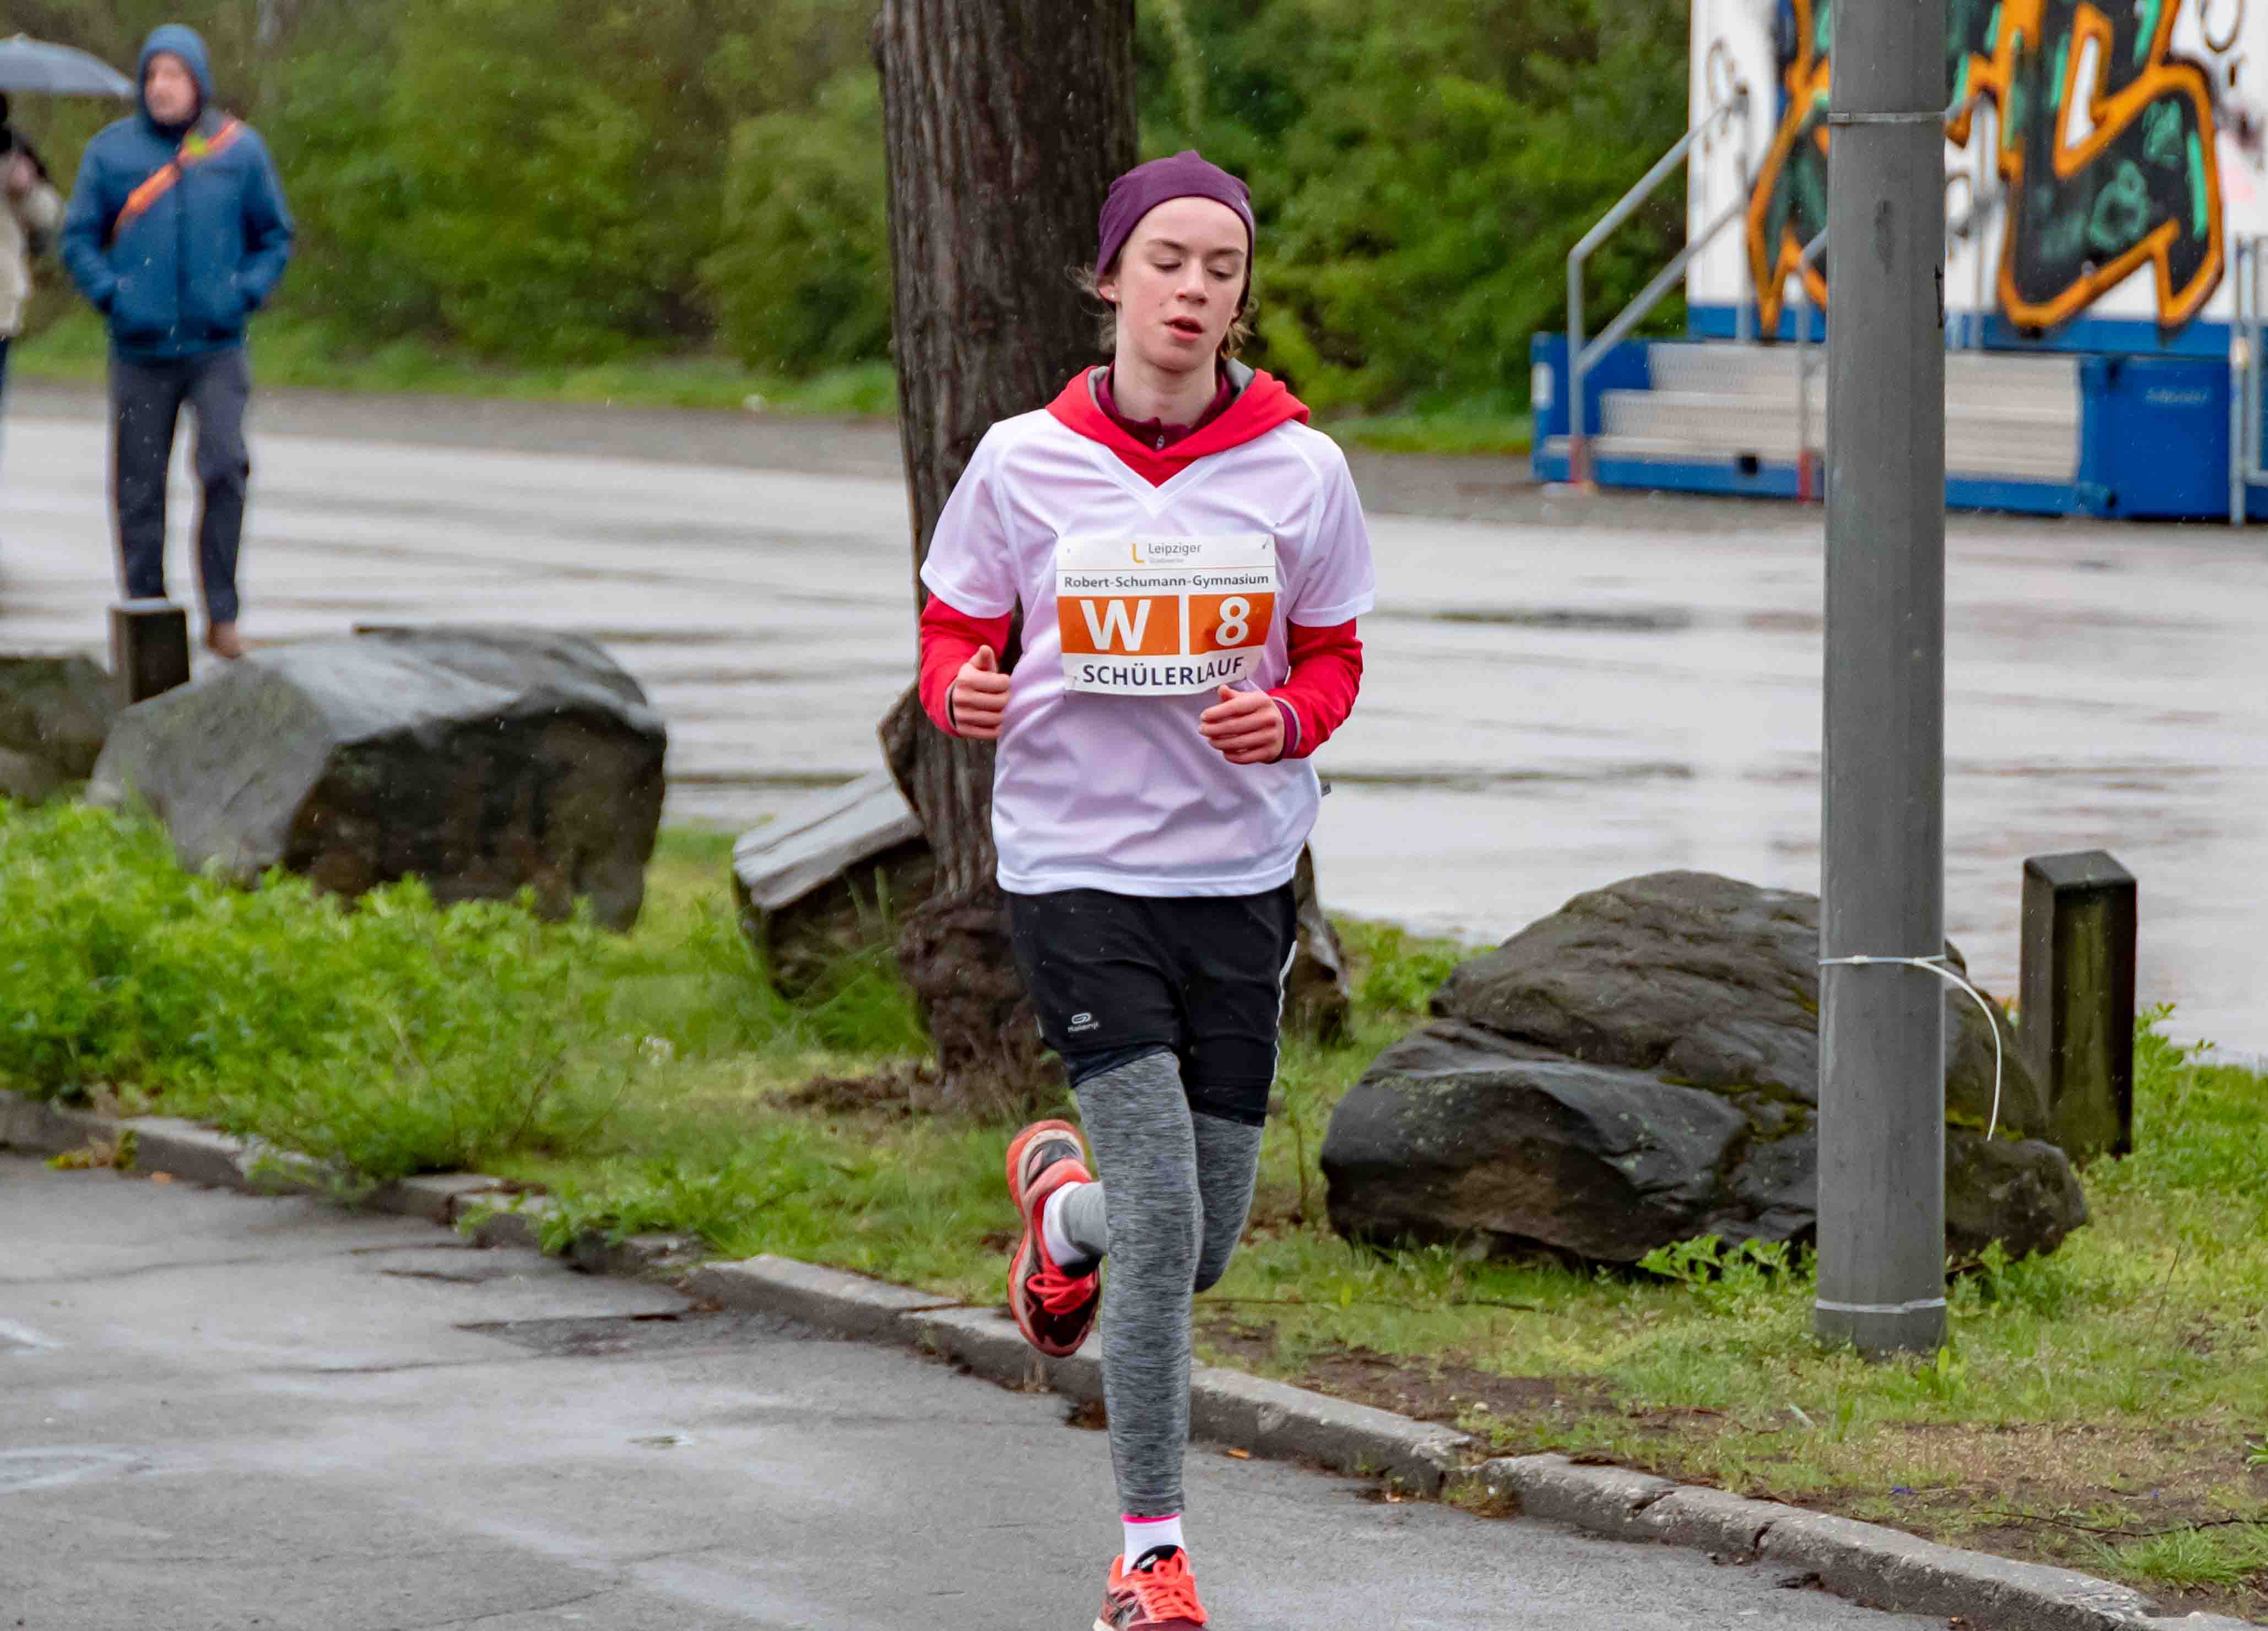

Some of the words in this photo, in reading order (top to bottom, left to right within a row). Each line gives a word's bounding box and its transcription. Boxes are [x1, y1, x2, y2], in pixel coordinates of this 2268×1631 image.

[1148, 543, 1202, 556] Leipziger
[1064, 574, 1269, 588] Robert-Schumann-Gymnasium
[1080, 599, 1151, 652] W
[1215, 596, 1250, 646] 8
[1083, 656, 1243, 686] SCHÜLERLAUF
